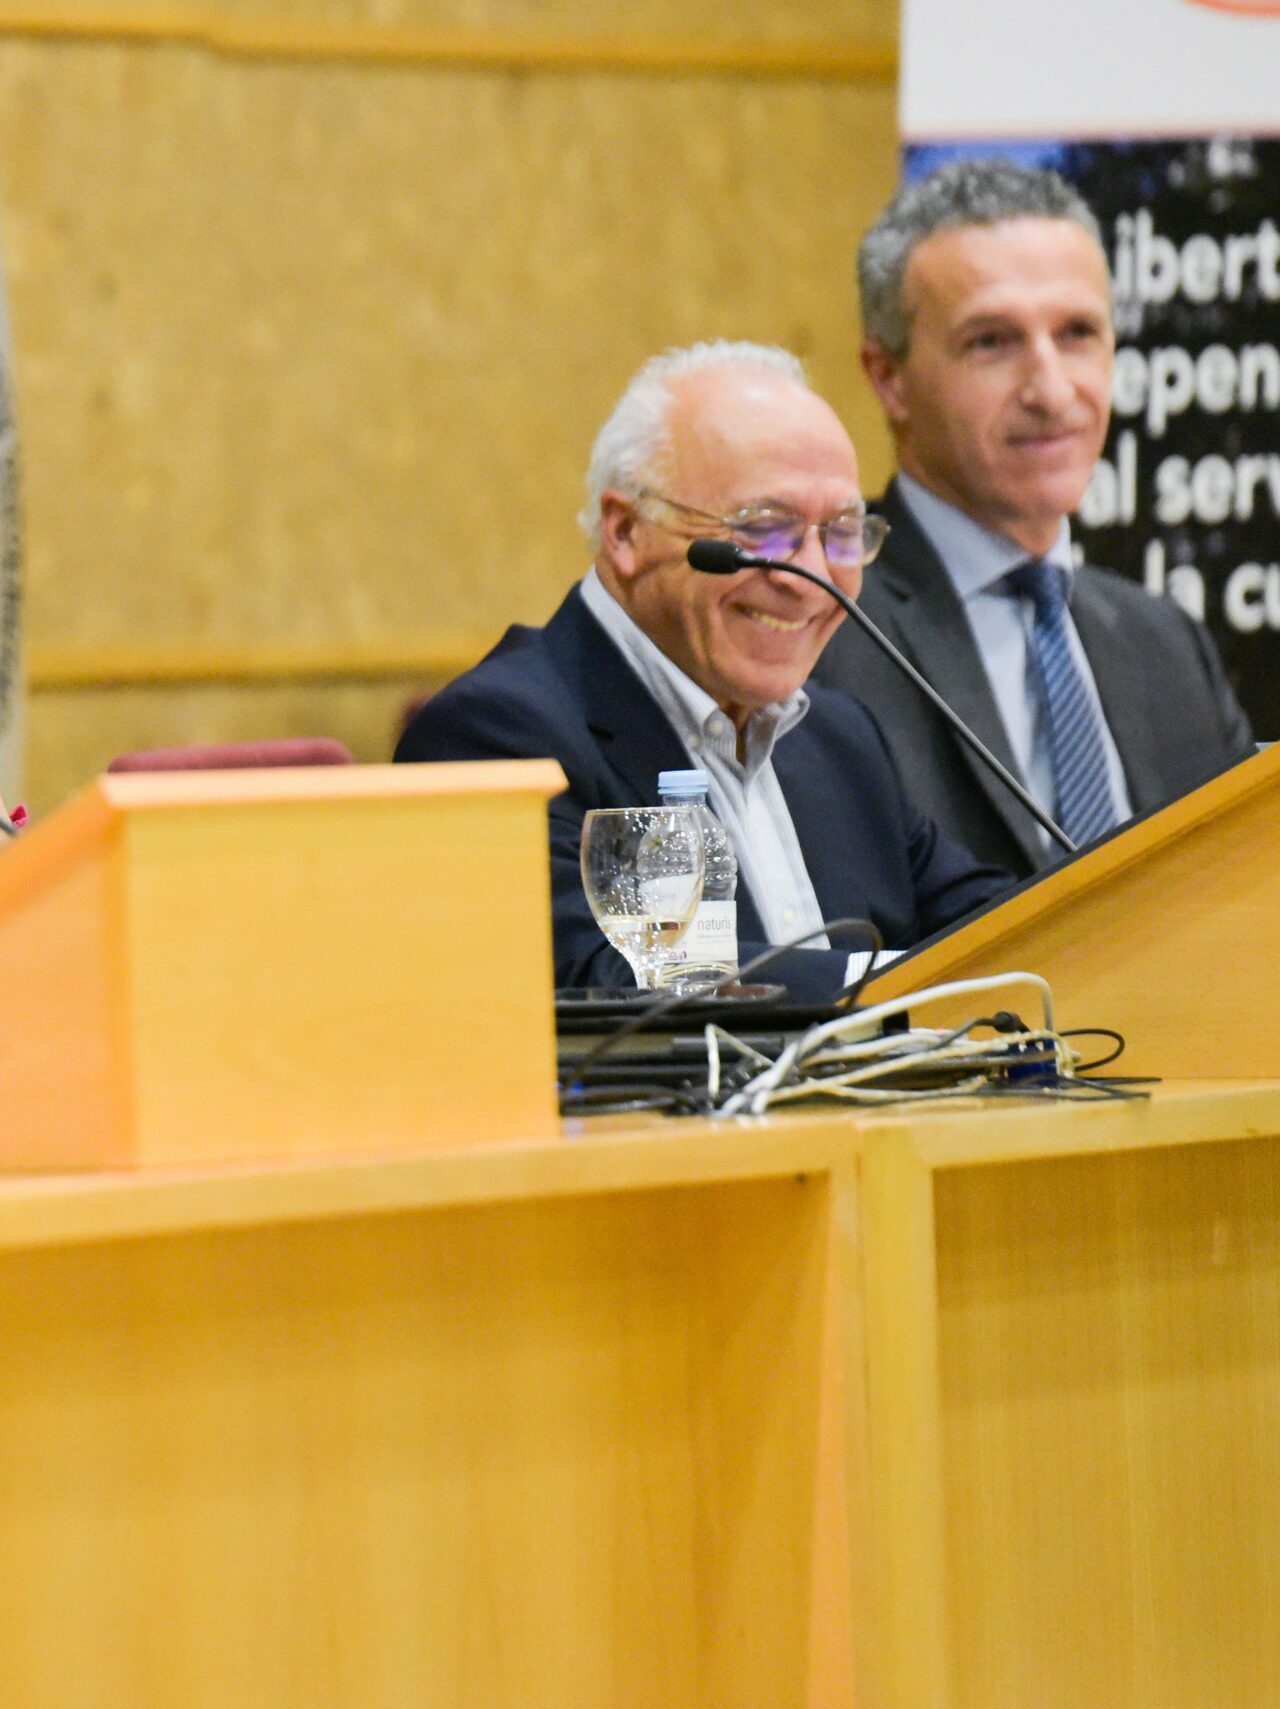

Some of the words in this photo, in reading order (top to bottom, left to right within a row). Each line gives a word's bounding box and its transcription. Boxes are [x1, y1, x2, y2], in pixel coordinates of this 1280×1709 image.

[1112, 343, 1280, 437] epen
[1080, 430, 1136, 527] al
[697, 915, 732, 931] naturis
